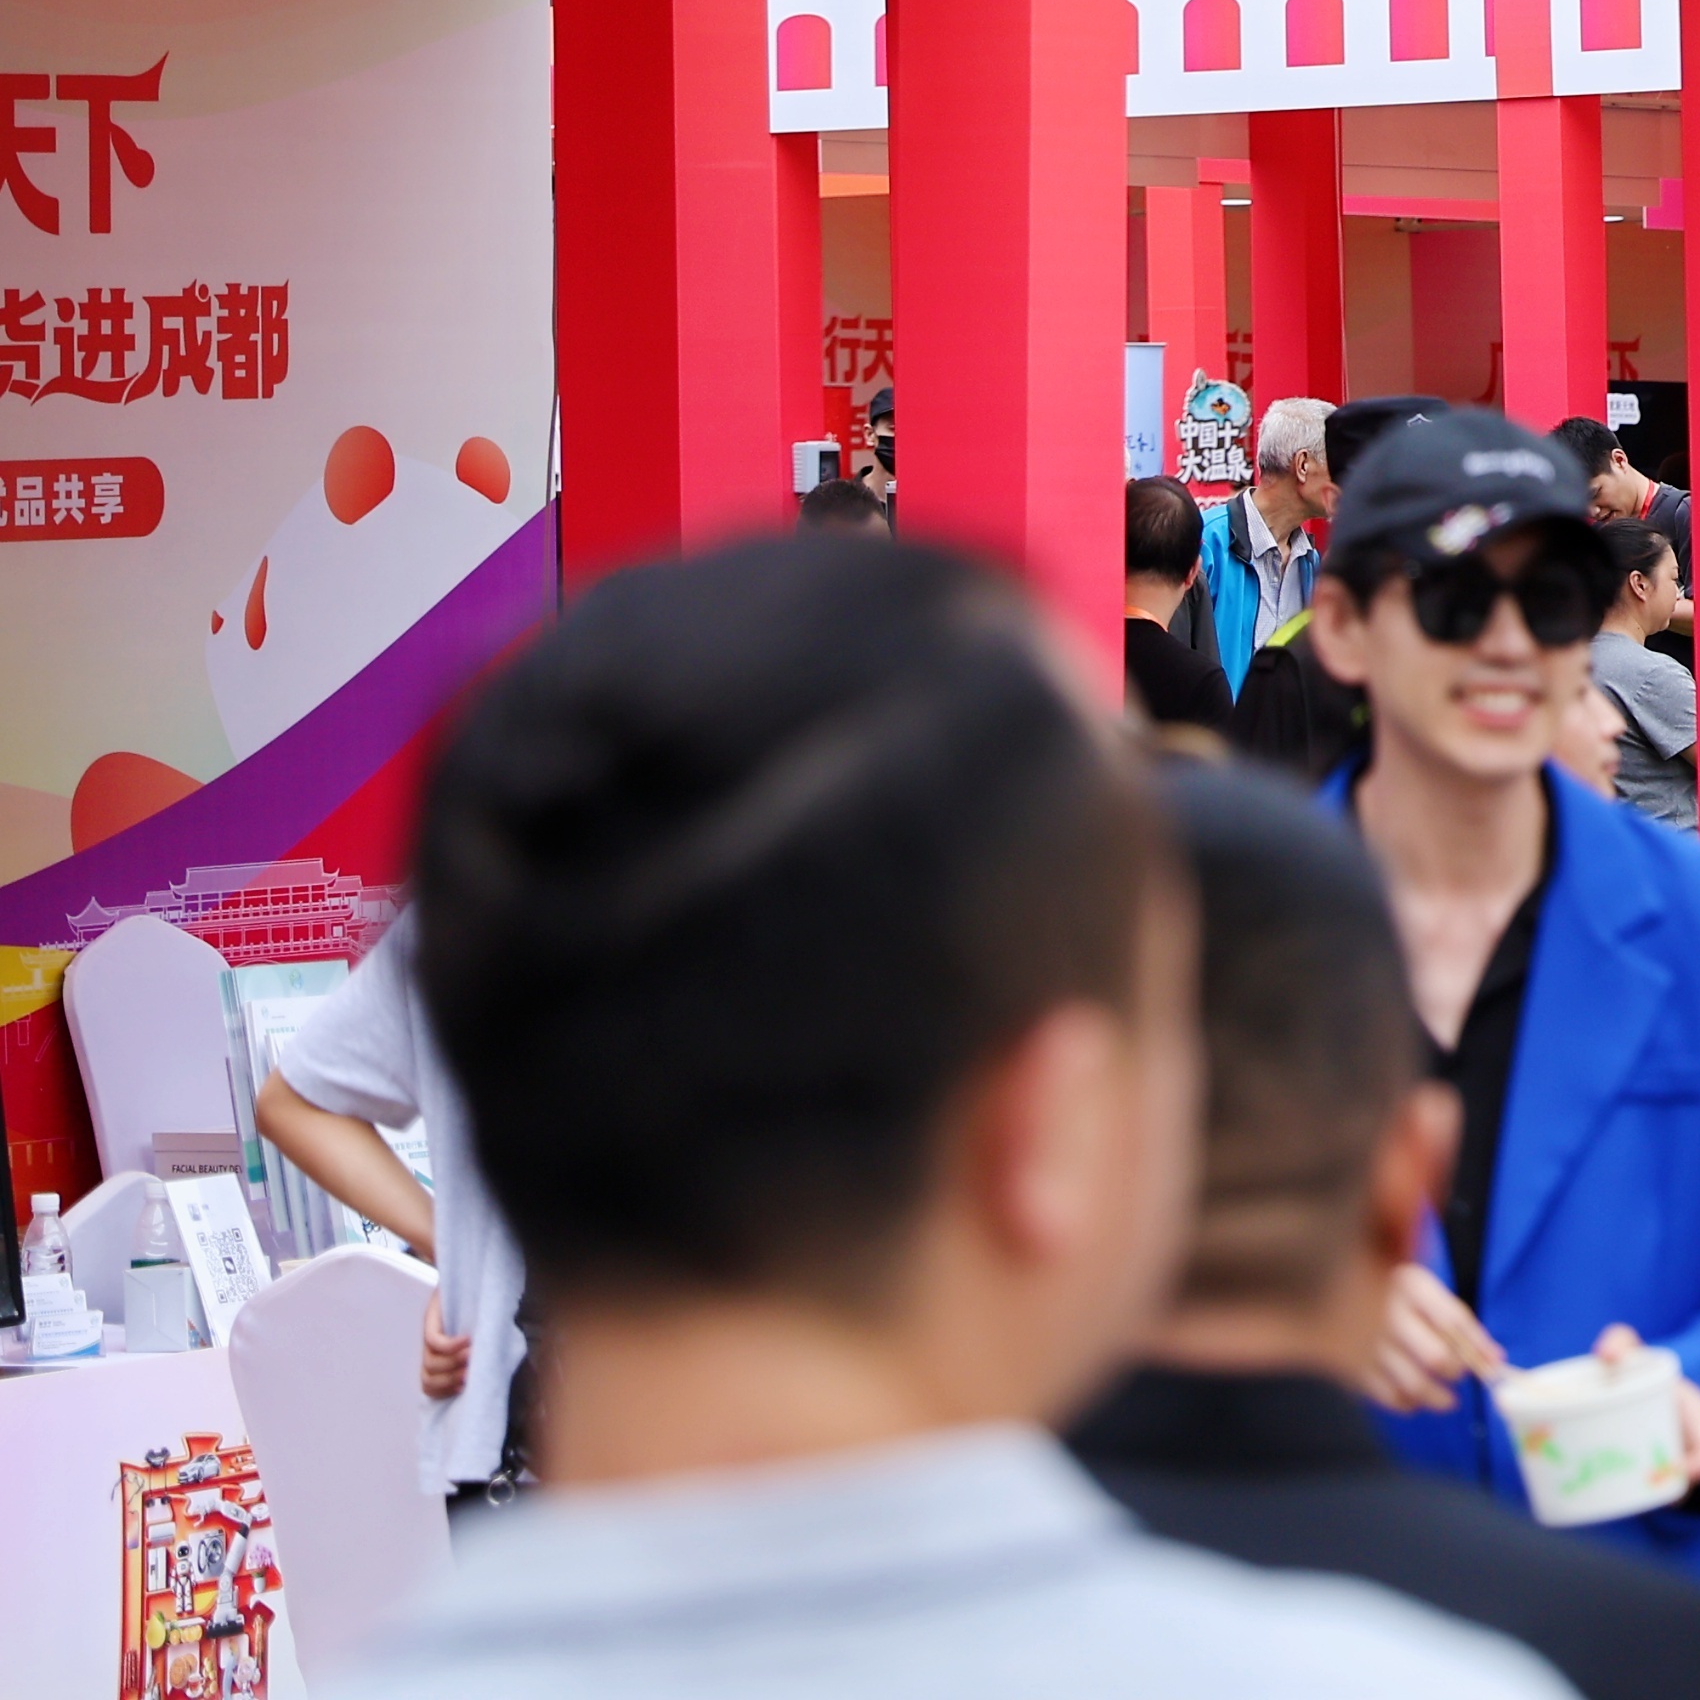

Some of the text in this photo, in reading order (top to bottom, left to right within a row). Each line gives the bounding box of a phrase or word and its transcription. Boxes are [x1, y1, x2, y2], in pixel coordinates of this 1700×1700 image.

[1179, 414, 1239, 450] 中国十
[1182, 446, 1254, 485] 大温泉
[0, 472, 124, 527] 品共享
[171, 1164, 197, 1174] FACIAL
[198, 1164, 227, 1174] BEAUTY
